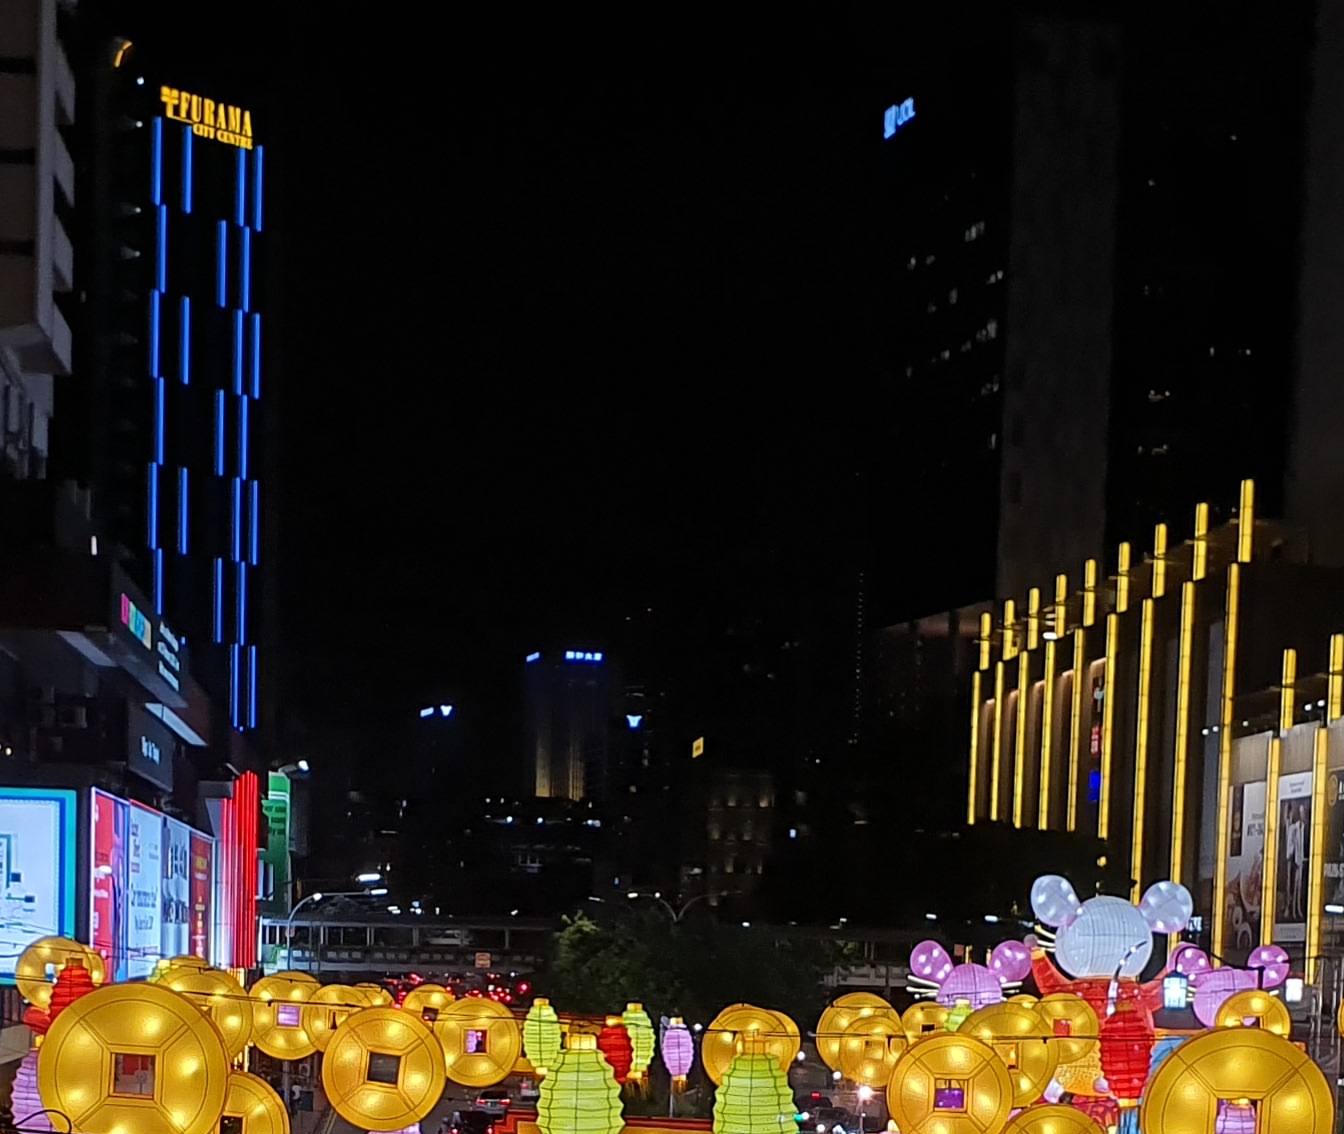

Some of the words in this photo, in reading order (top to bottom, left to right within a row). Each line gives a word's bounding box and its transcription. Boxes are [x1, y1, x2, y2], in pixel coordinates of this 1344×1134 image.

[179, 91, 252, 138] FURAMA
[193, 123, 215, 139] CITY
[216, 129, 253, 150] CENTRE
